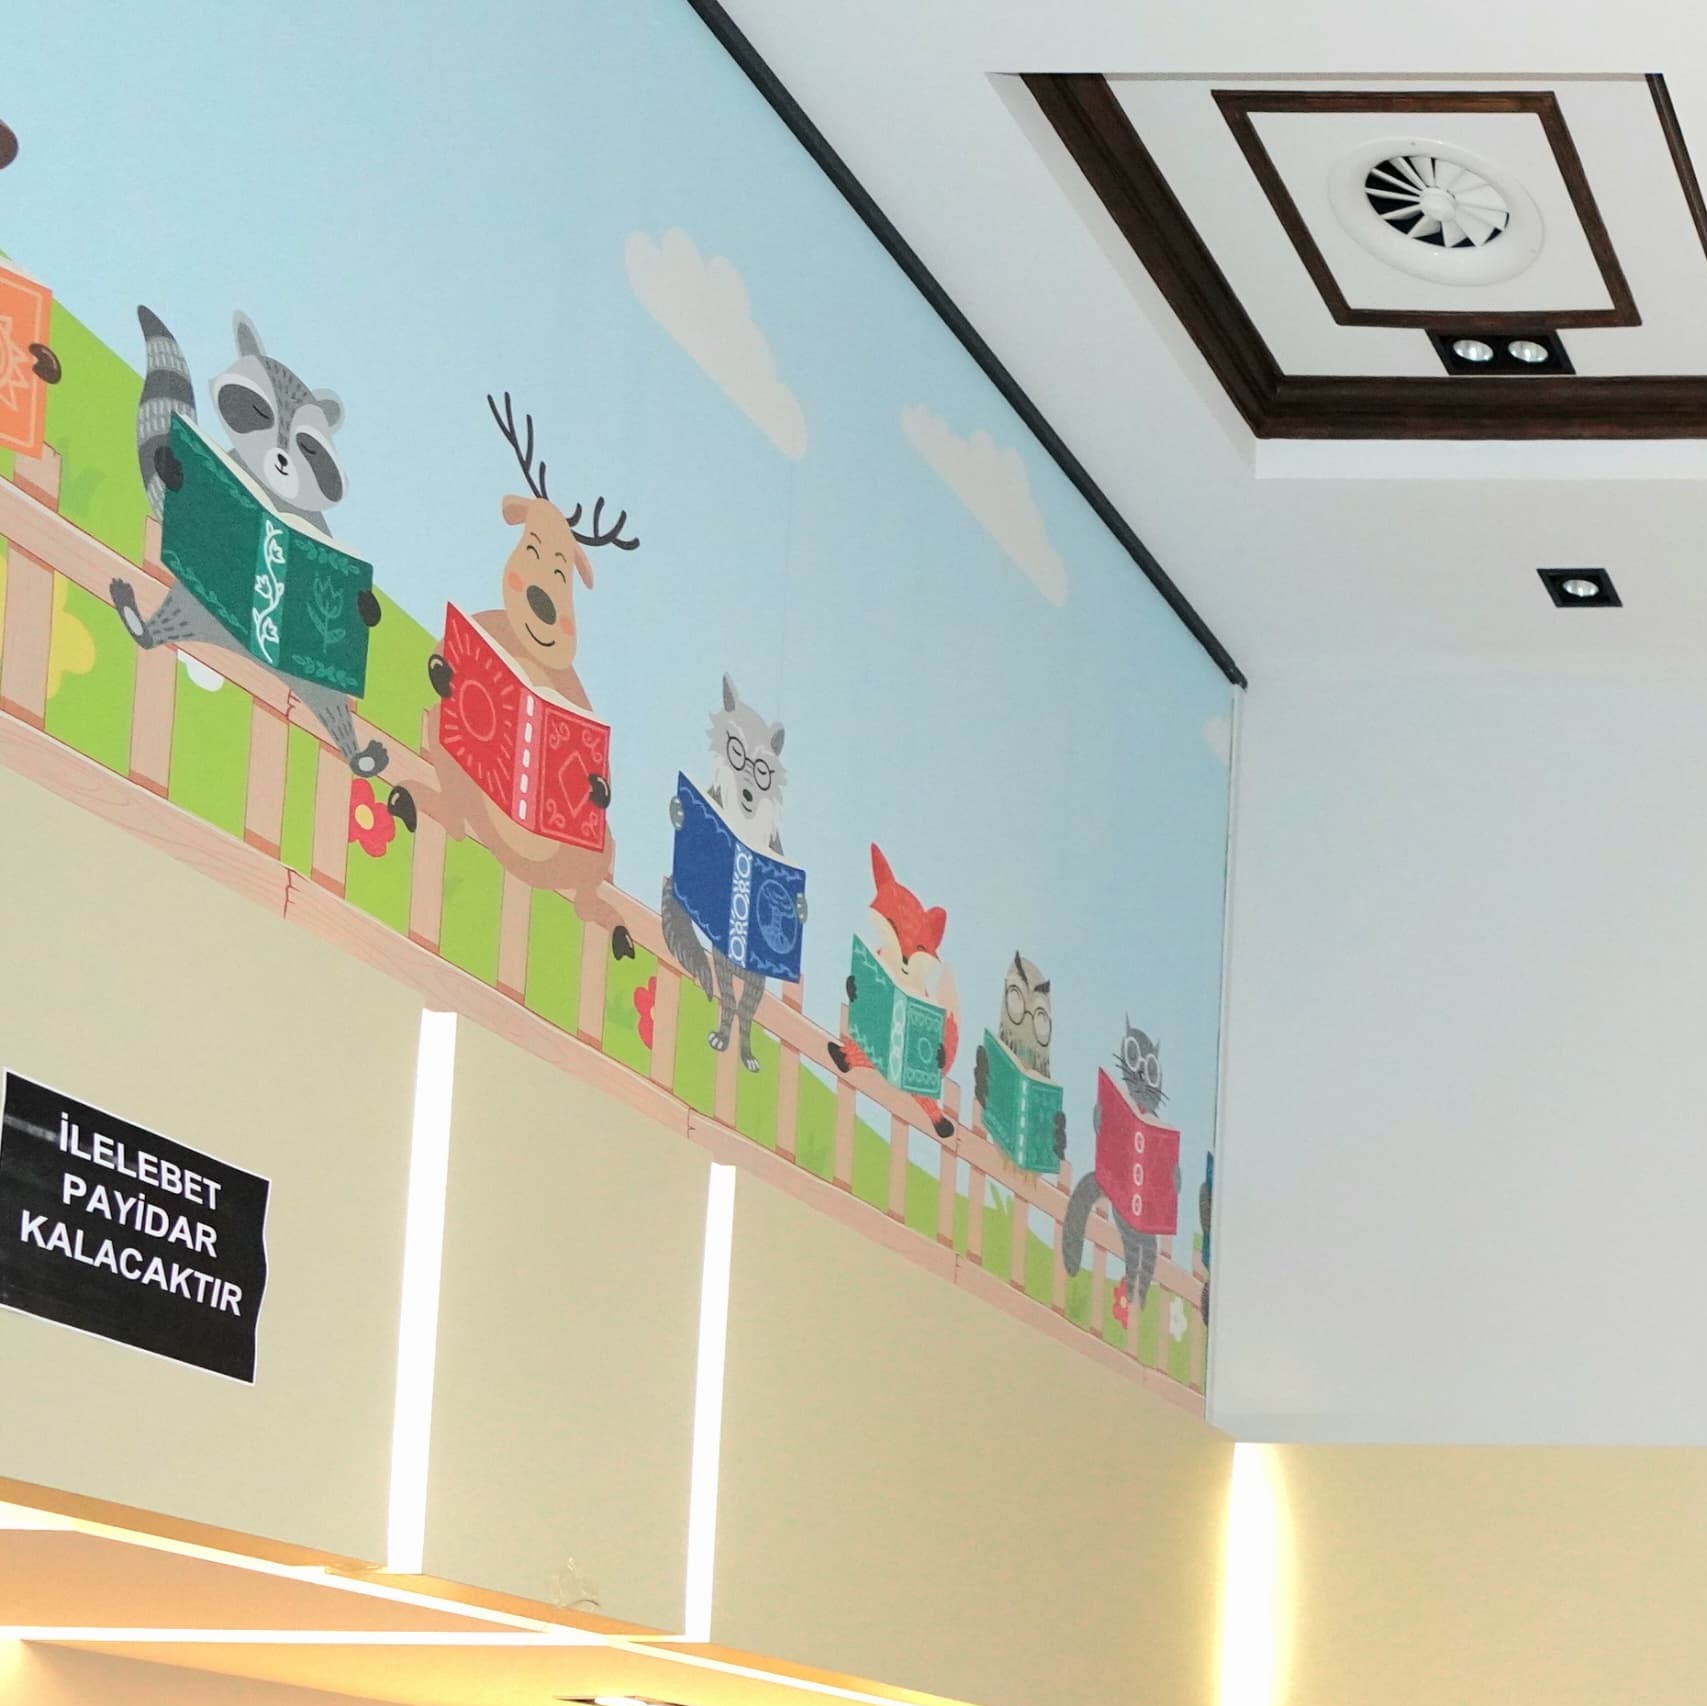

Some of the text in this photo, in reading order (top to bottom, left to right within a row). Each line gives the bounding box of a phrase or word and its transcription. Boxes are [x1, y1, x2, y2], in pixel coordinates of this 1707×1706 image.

[59, 1111, 222, 1211] İLELEBET
[19, 1209, 243, 1317] KALACAKTIR
[62, 1172, 218, 1259] PAYİDAR
